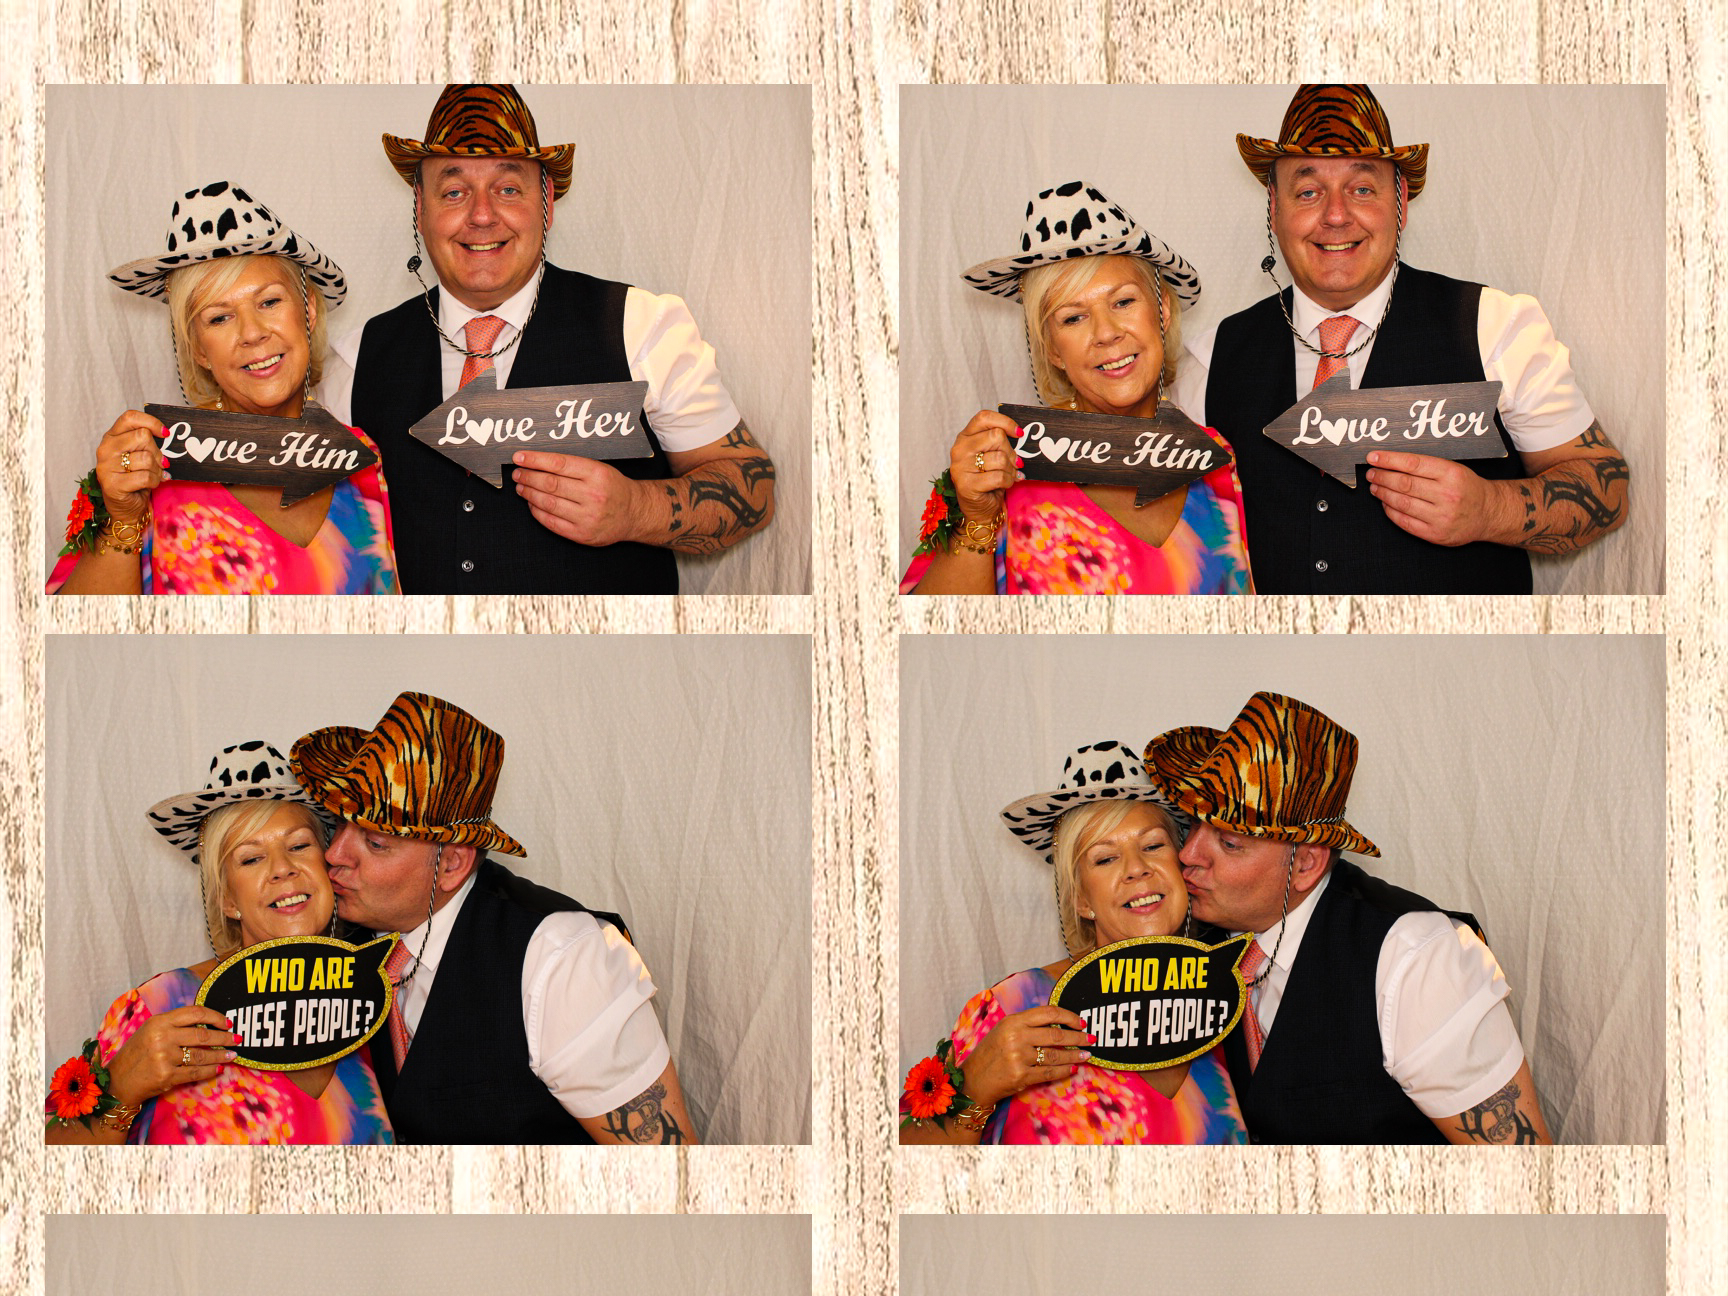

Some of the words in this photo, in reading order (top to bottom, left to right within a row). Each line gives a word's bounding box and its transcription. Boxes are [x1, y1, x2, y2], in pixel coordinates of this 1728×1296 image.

[549, 398, 635, 439] Her
[1403, 398, 1489, 439] Her
[269, 431, 359, 470] Him
[1123, 431, 1213, 470] Him
[245, 957, 305, 993] WHO
[309, 956, 355, 990] ARE
[1099, 957, 1159, 993] WHO
[1163, 956, 1209, 990] ARE
